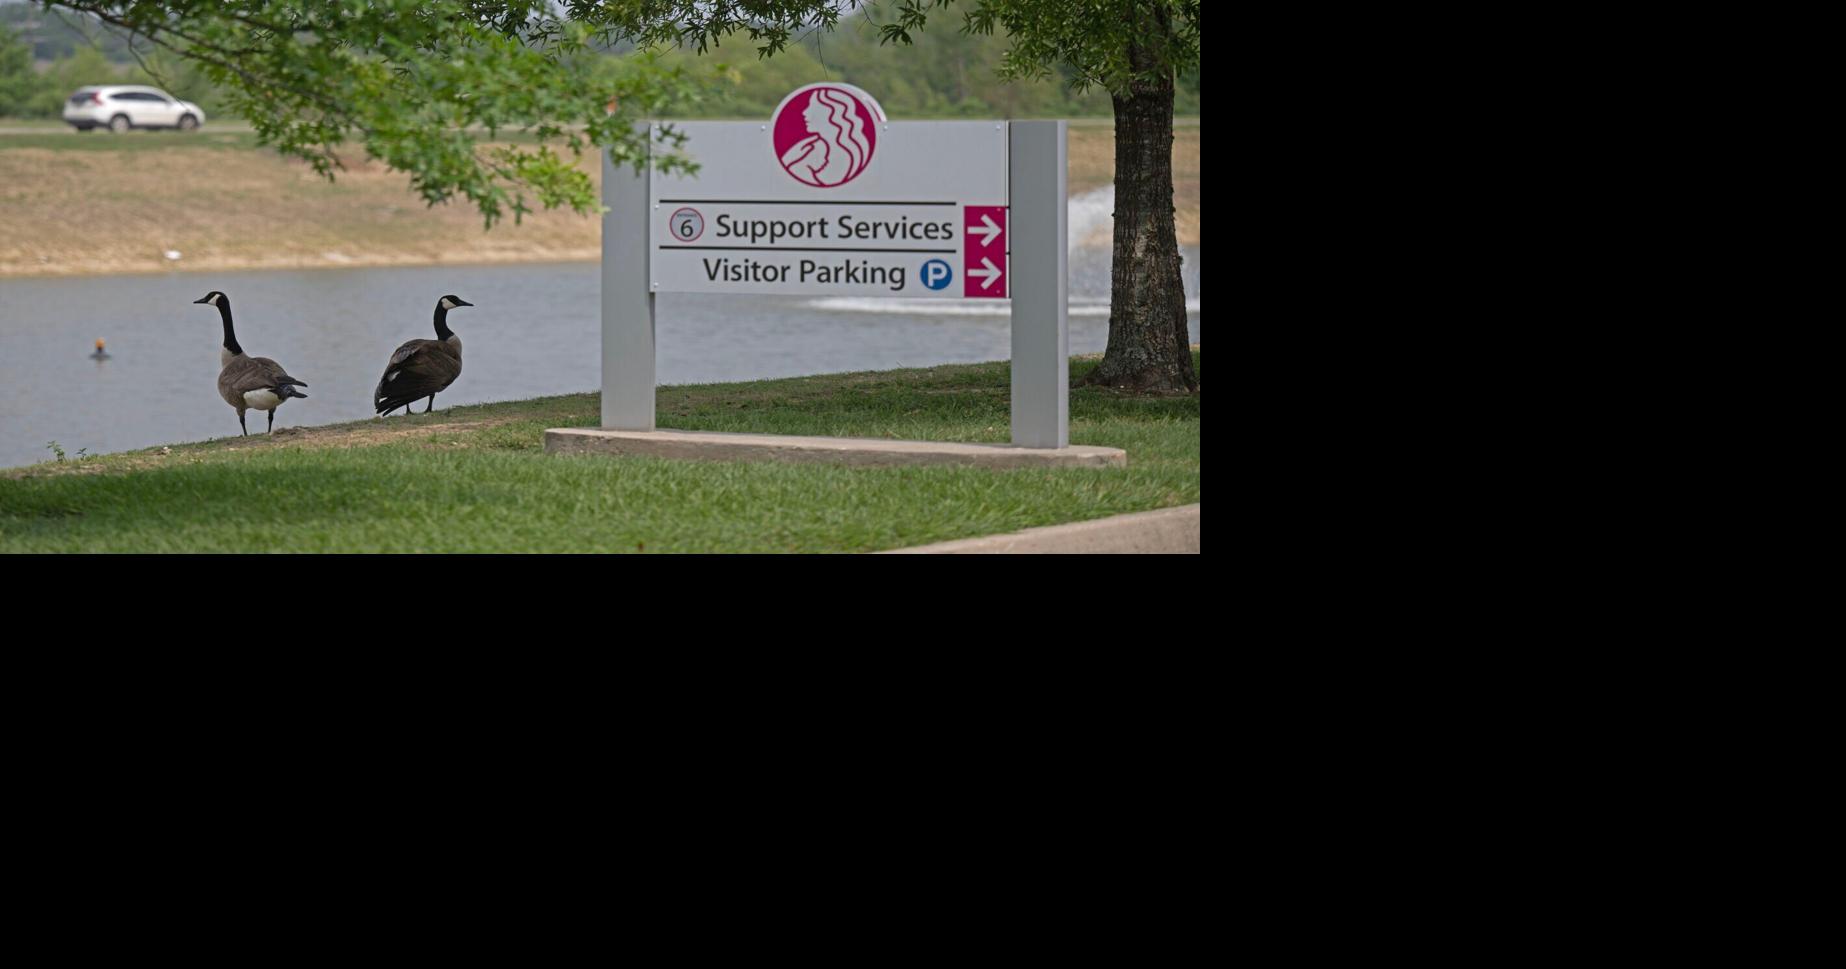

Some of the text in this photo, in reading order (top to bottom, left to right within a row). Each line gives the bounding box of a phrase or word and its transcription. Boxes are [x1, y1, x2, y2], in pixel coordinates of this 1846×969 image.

[680, 214, 954, 244] 6 Support Services
[702, 257, 946, 291] Visitor Parking P
